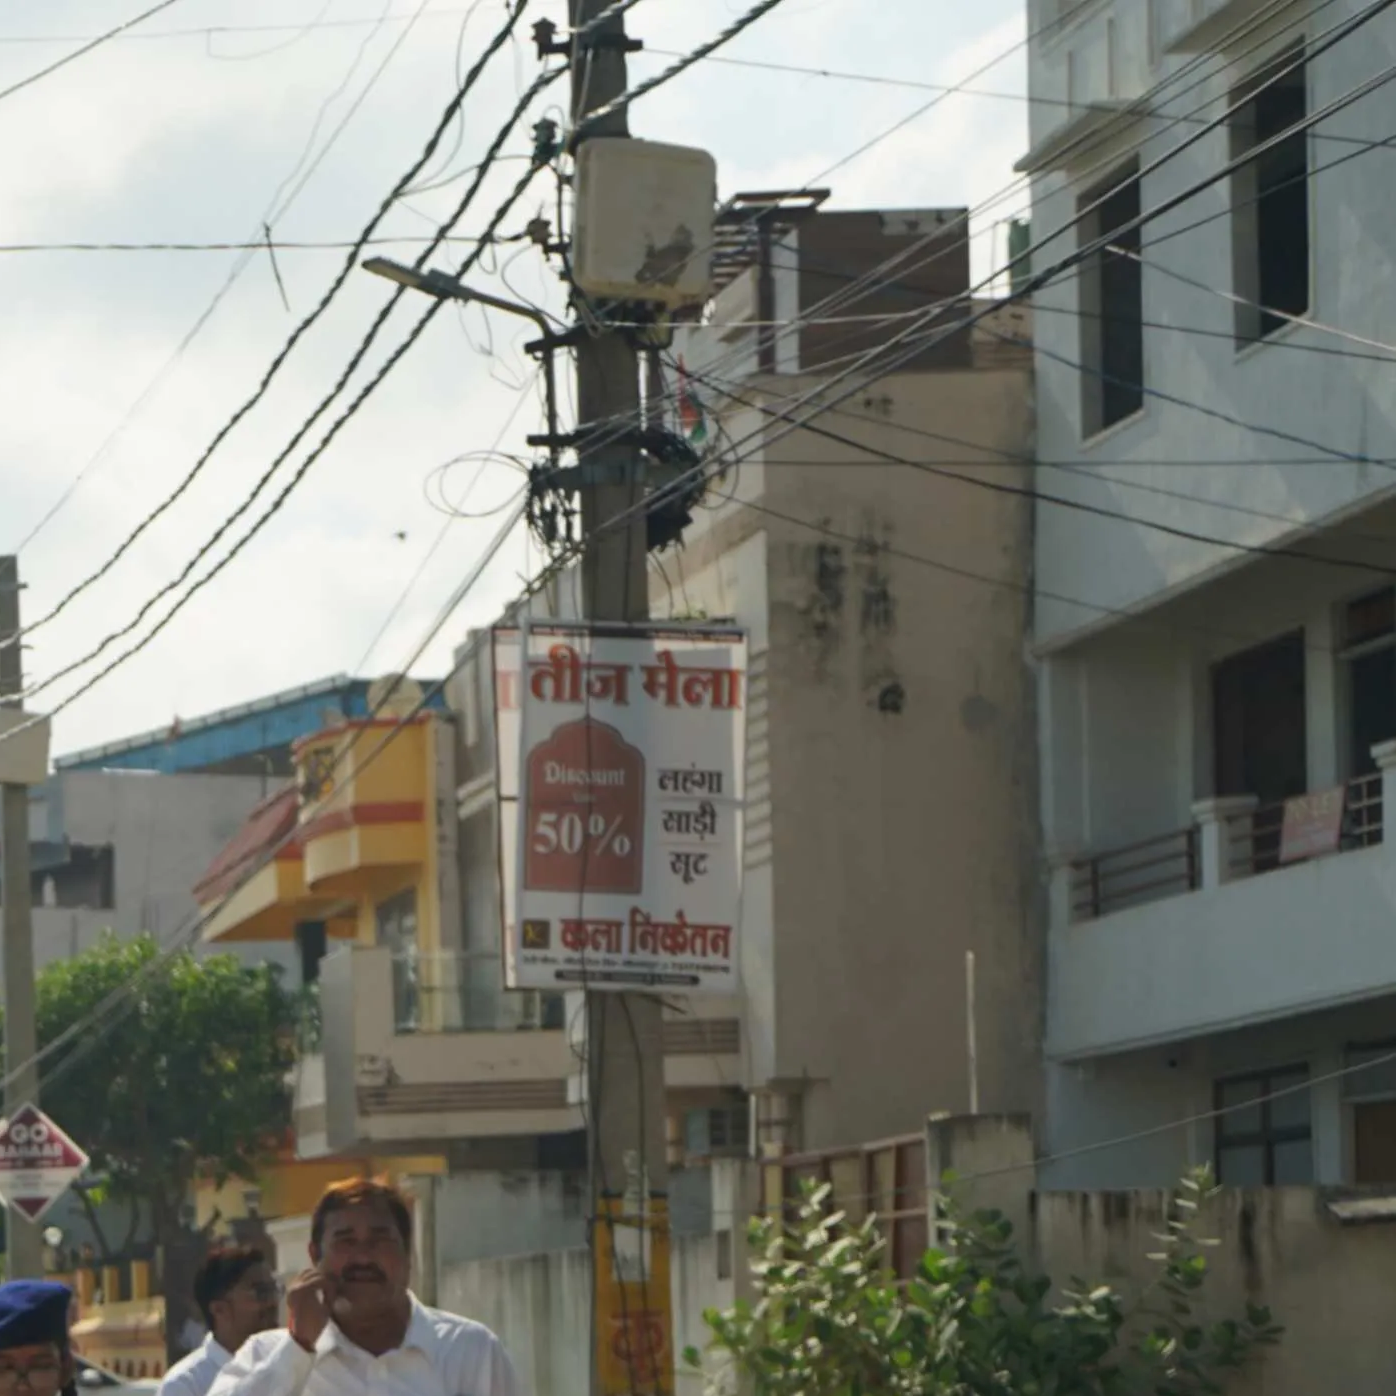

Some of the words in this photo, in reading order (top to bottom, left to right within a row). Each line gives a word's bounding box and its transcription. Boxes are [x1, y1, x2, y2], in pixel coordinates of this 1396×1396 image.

[527, 643, 633, 706] तीज
[639, 648, 745, 710] मेला
[543, 760, 626, 786] Discount
[657, 762, 723, 794] लहंगा
[533, 812, 632, 857] 50%
[662, 801, 717, 841] साड़ी
[669, 850, 711, 885] सूट
[559, 918, 624, 953] कला
[628, 905, 732, 960] निकेतन
